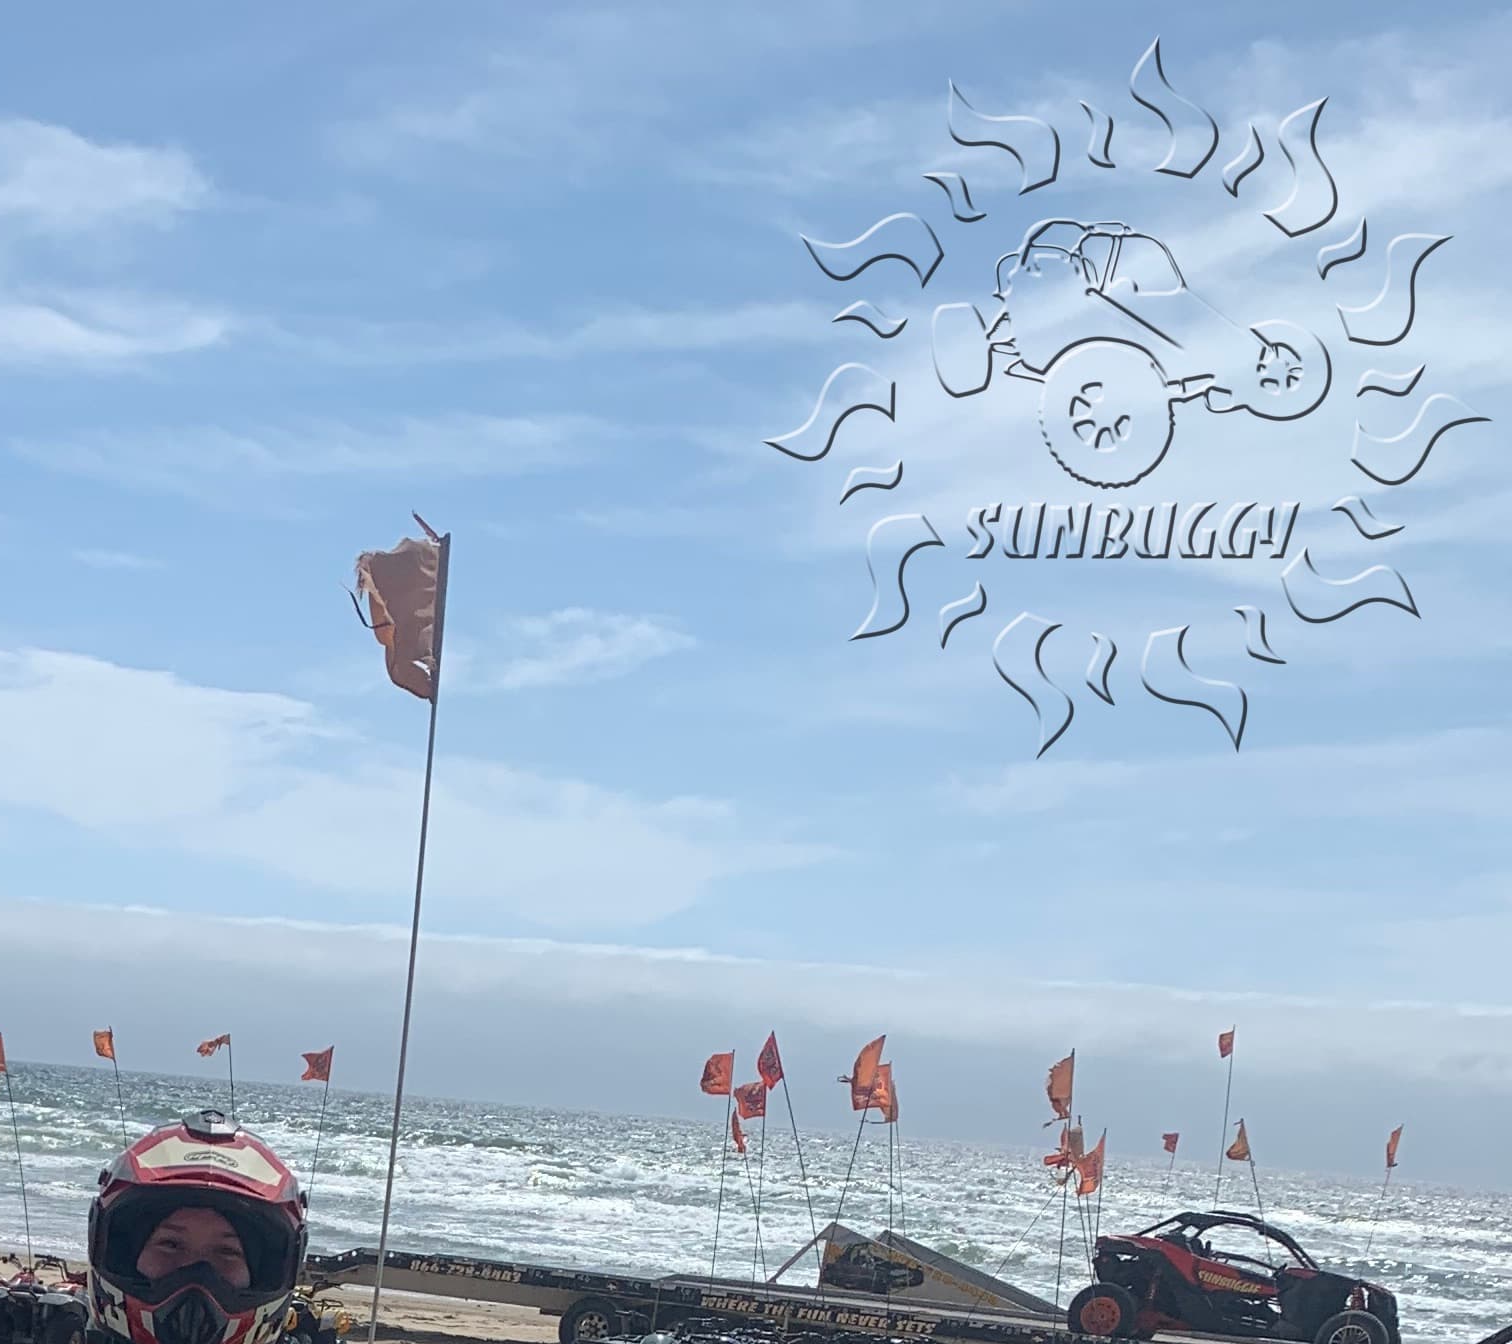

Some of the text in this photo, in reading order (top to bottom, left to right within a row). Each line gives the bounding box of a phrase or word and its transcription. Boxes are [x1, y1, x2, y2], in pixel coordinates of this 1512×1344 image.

[1198, 1269, 1263, 1294] SUNBUGGIE
[700, 1295, 937, 1335] WHERE THE FUN NEVER SETS
